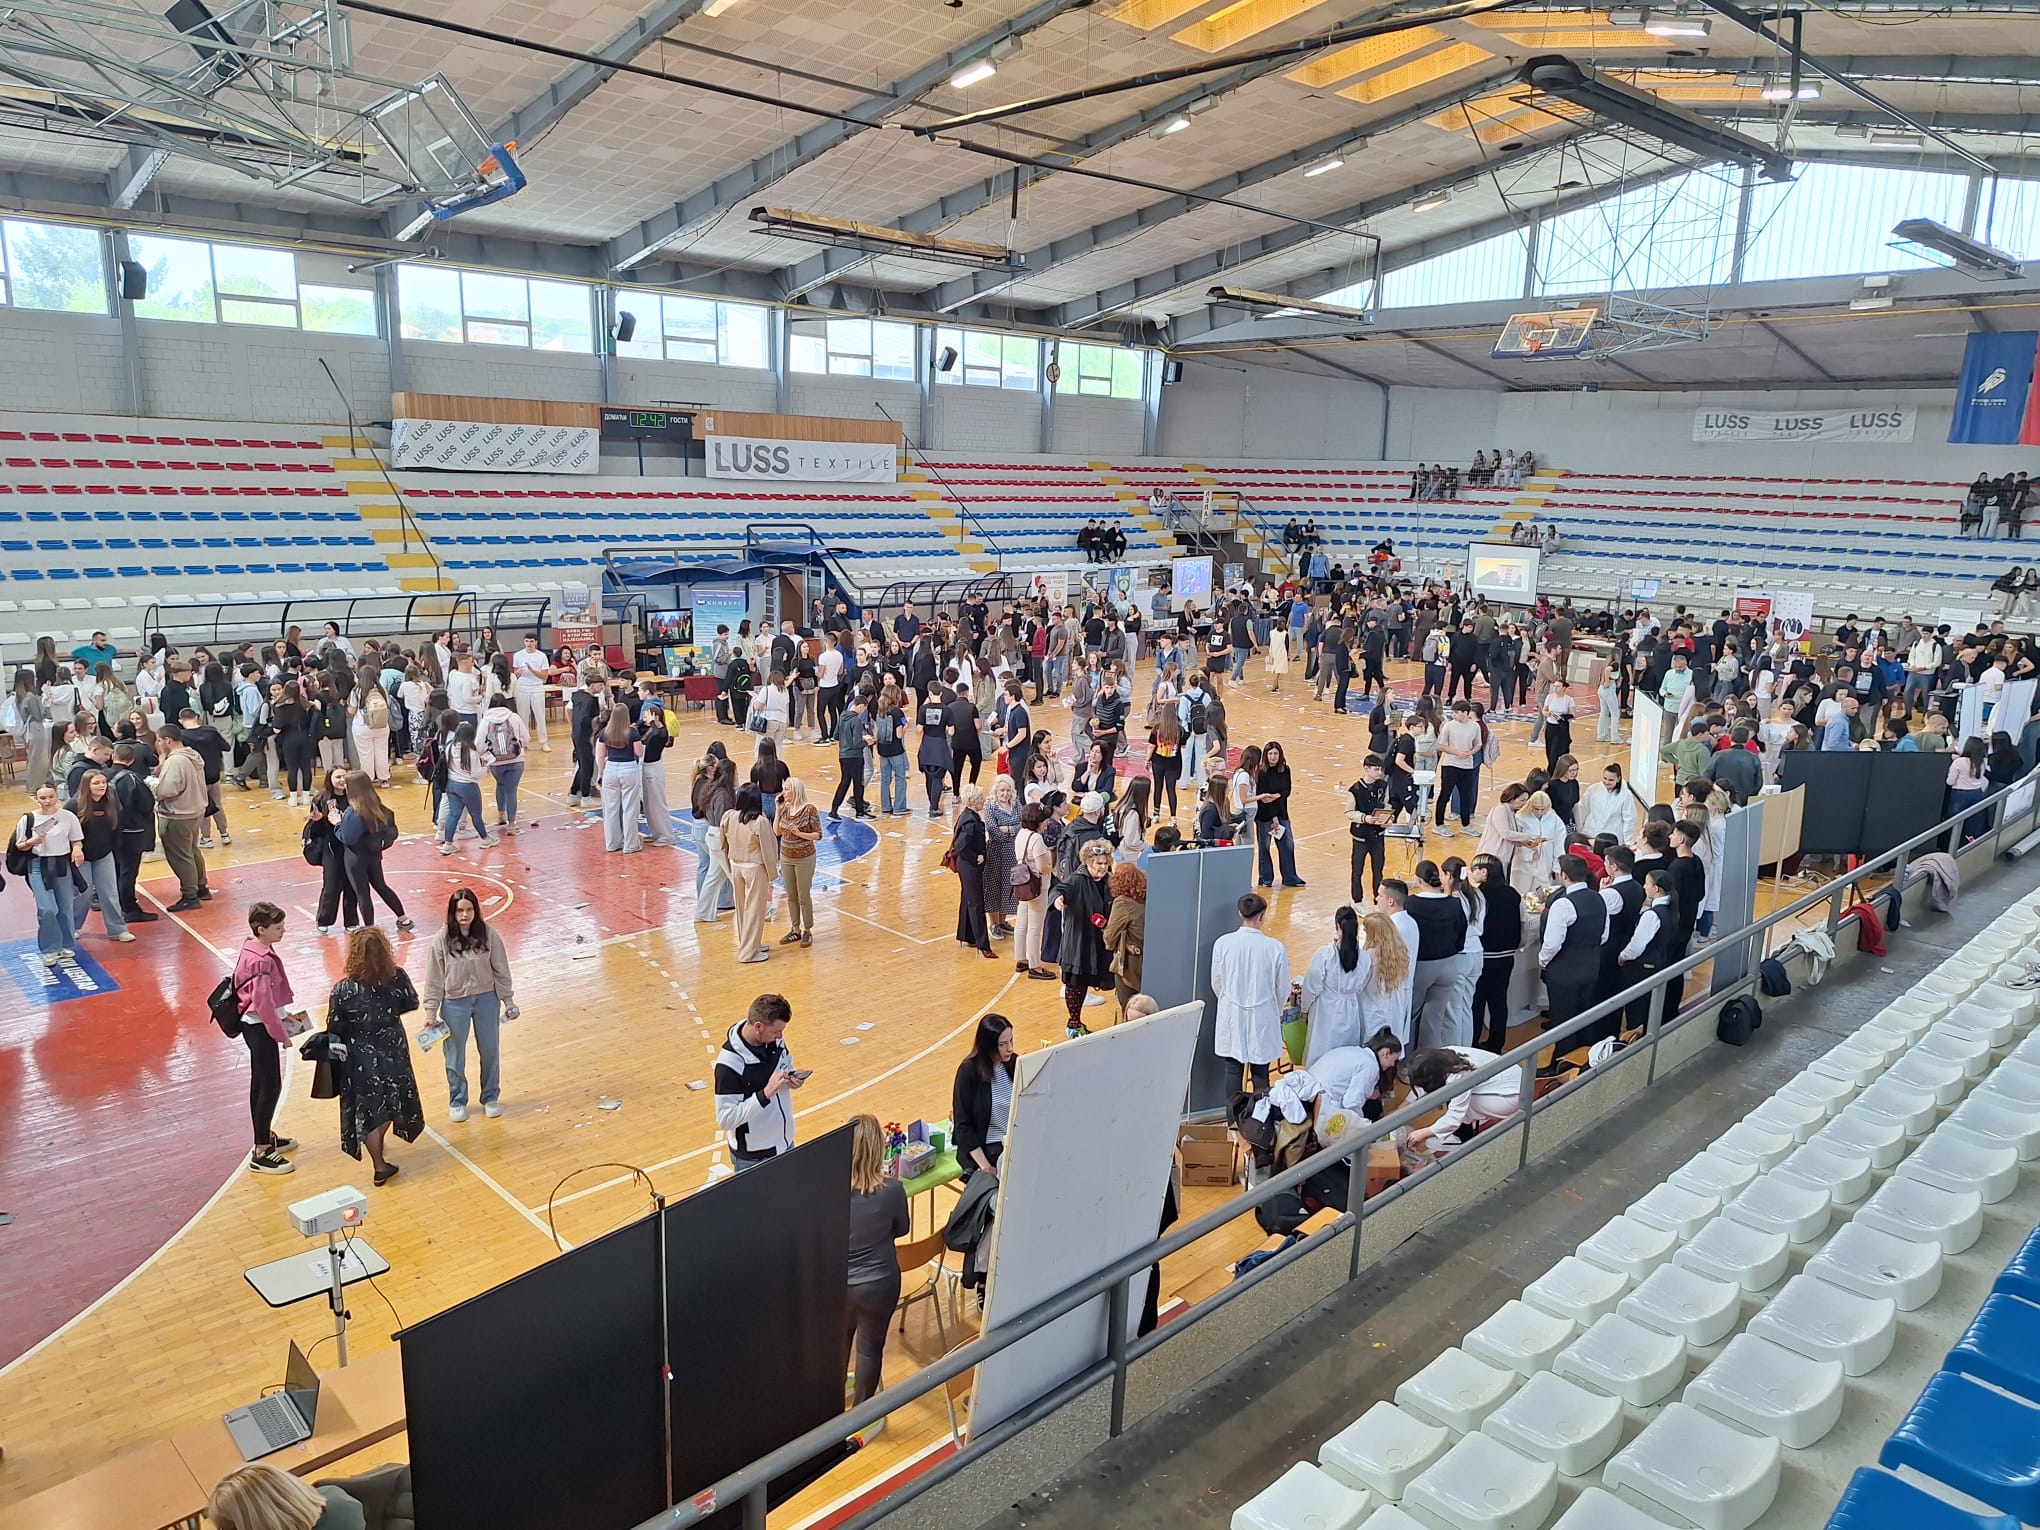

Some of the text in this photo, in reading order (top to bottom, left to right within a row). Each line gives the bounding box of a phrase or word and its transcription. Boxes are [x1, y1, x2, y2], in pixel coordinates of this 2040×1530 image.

[1704, 414, 1751, 430] LUSS
[1774, 417, 1825, 432] LUSS
[1850, 412, 1903, 429] LUSS
[411, 421, 432, 440] LUSS
[435, 422, 456, 442] LUSS
[459, 424, 480, 444] LUSS
[482, 426, 502, 444] LUSS
[506, 426, 524, 446] LUSS
[528, 428, 546, 446] LUSS
[549, 428, 568, 447] LUSS
[570, 430, 588, 448] LUSS
[413, 443, 434, 463] LUSS
[437, 445, 458, 464] LUSS
[461, 446, 480, 464] LUSS
[484, 447, 504, 466] LUSS
[506, 448, 526, 466] LUSS
[528, 449, 548, 467] LUSS
[550, 450, 568, 468] LUSS
[570, 450, 590, 468] LUSS
[715, 442, 890, 475] LUSS TEXTILE
